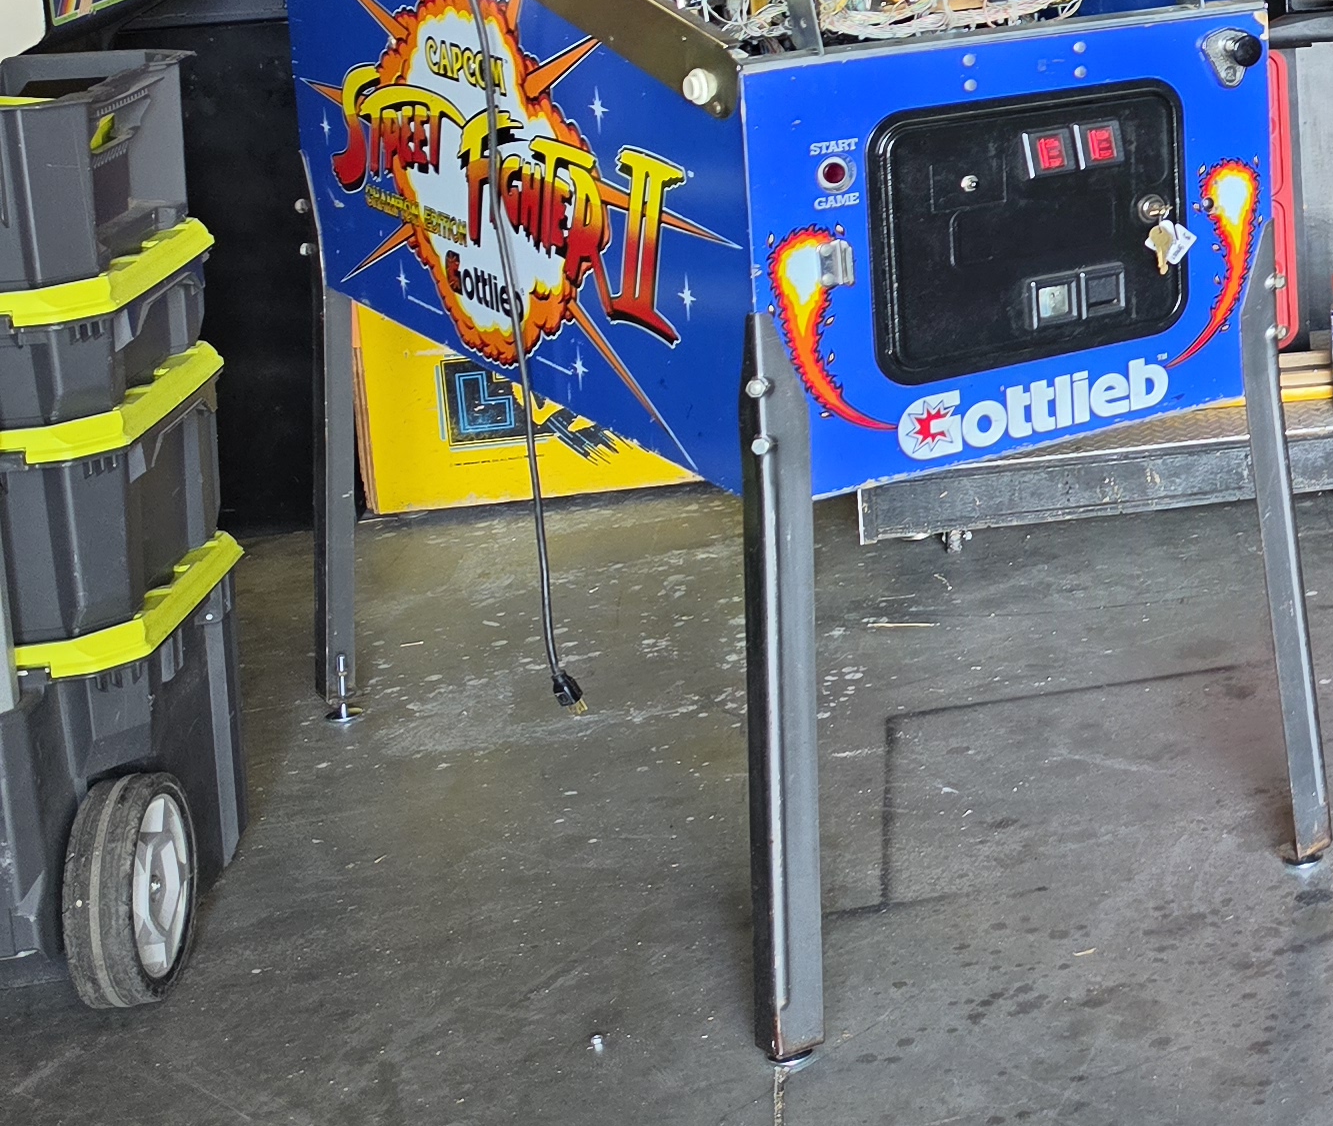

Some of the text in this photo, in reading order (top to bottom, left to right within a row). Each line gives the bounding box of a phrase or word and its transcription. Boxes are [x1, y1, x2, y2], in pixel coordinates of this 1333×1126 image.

[426, 36, 507, 97] CAPCOM
[332, 63, 467, 194] STREET
[810, 138, 858, 156] START
[813, 192, 860, 211] GAME
[446, 250, 524, 323] Gottlieb
[898, 358, 1168, 460] Gottlieb
